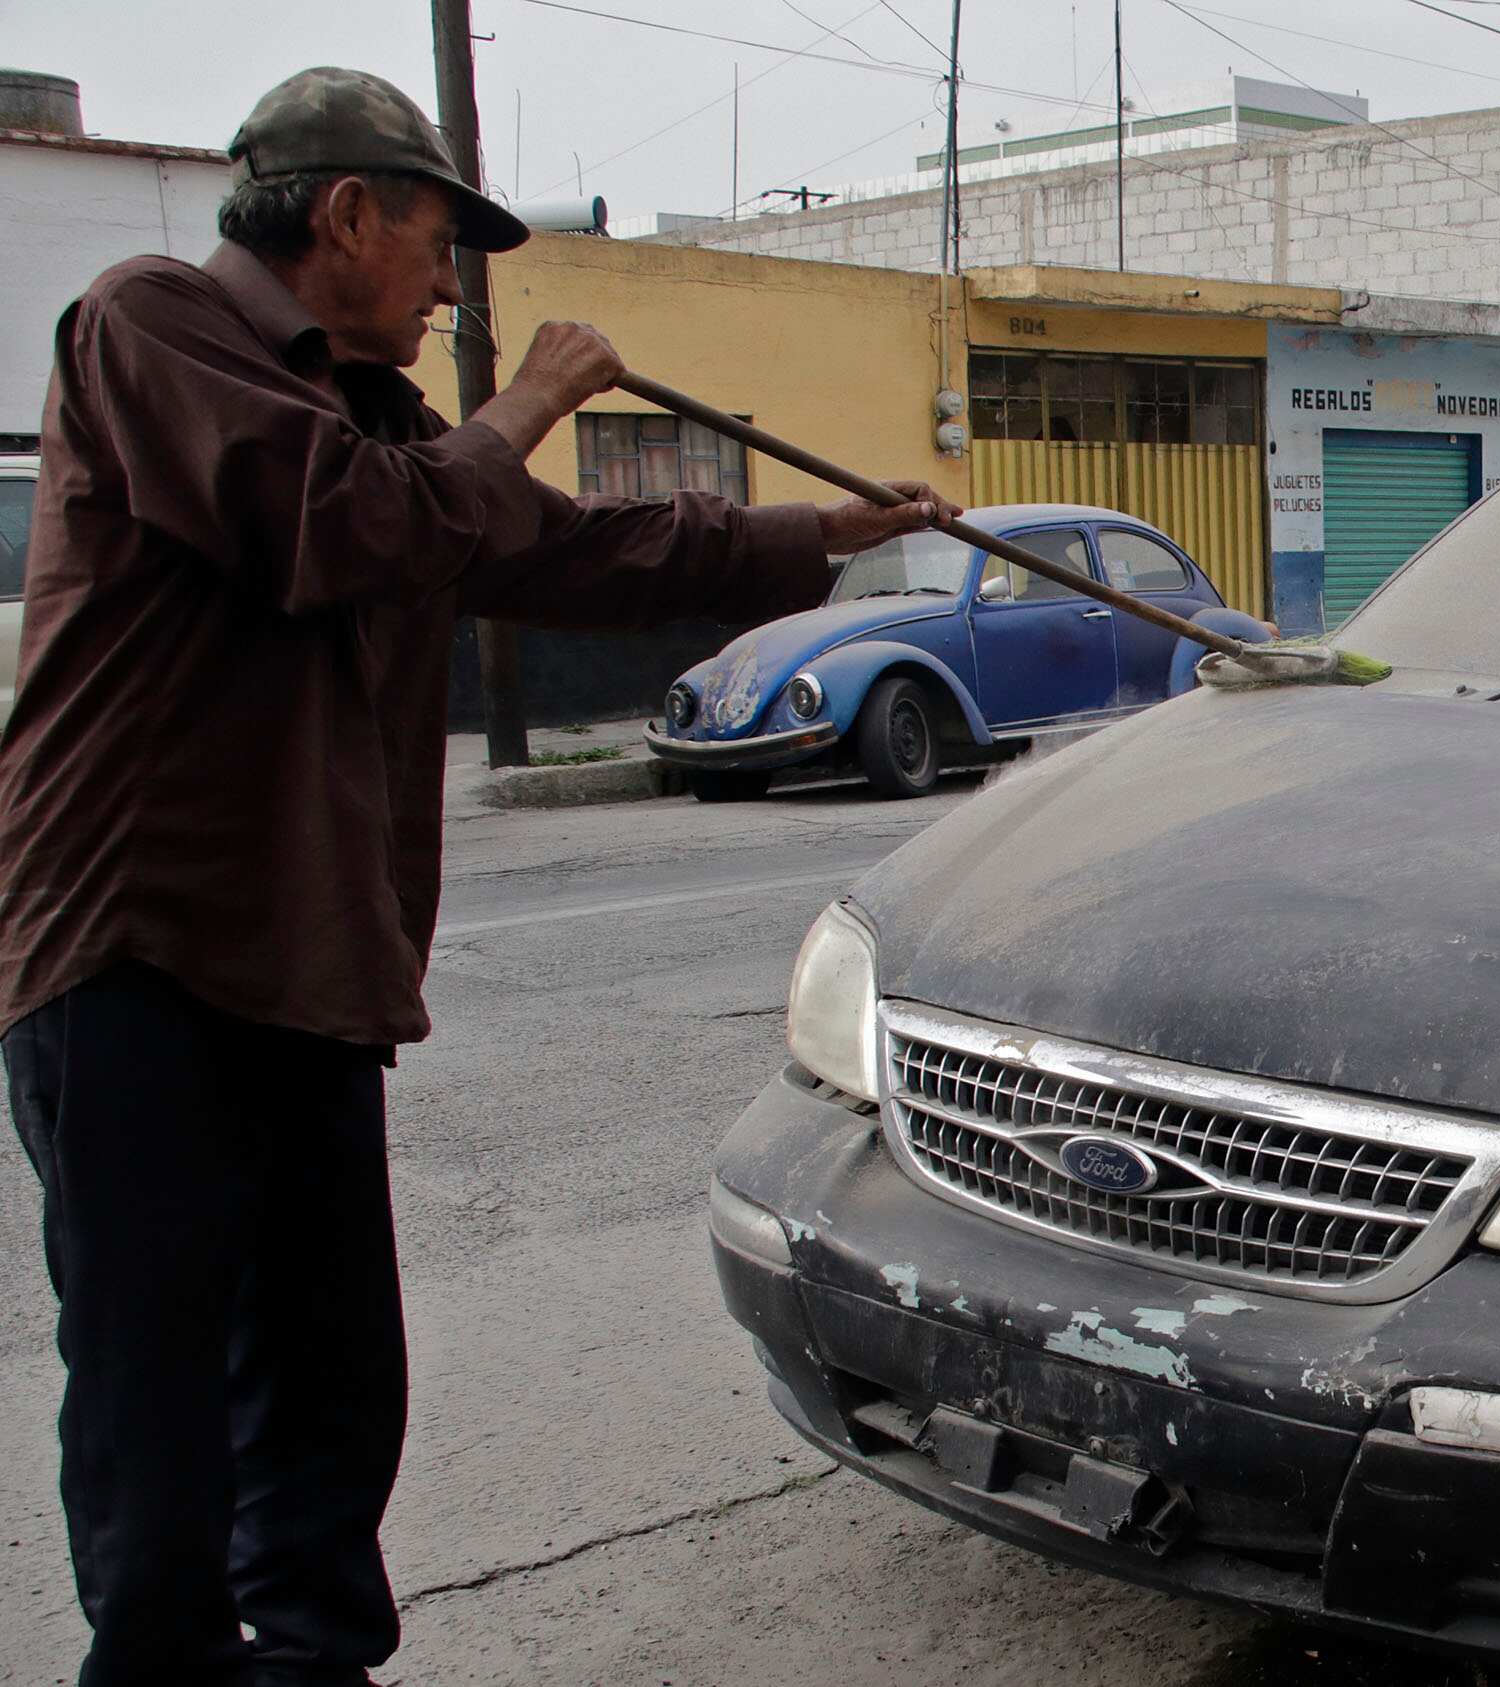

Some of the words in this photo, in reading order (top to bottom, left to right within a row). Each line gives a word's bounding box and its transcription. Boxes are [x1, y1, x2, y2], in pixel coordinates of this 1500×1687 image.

[1009, 317, 1046, 335] 804
[1292, 388, 1371, 411] REGALOS
[1273, 475, 1321, 489] JUGUETES
[1273, 498, 1321, 512] PELUCHES
[1080, 1146, 1129, 1181] Ford
